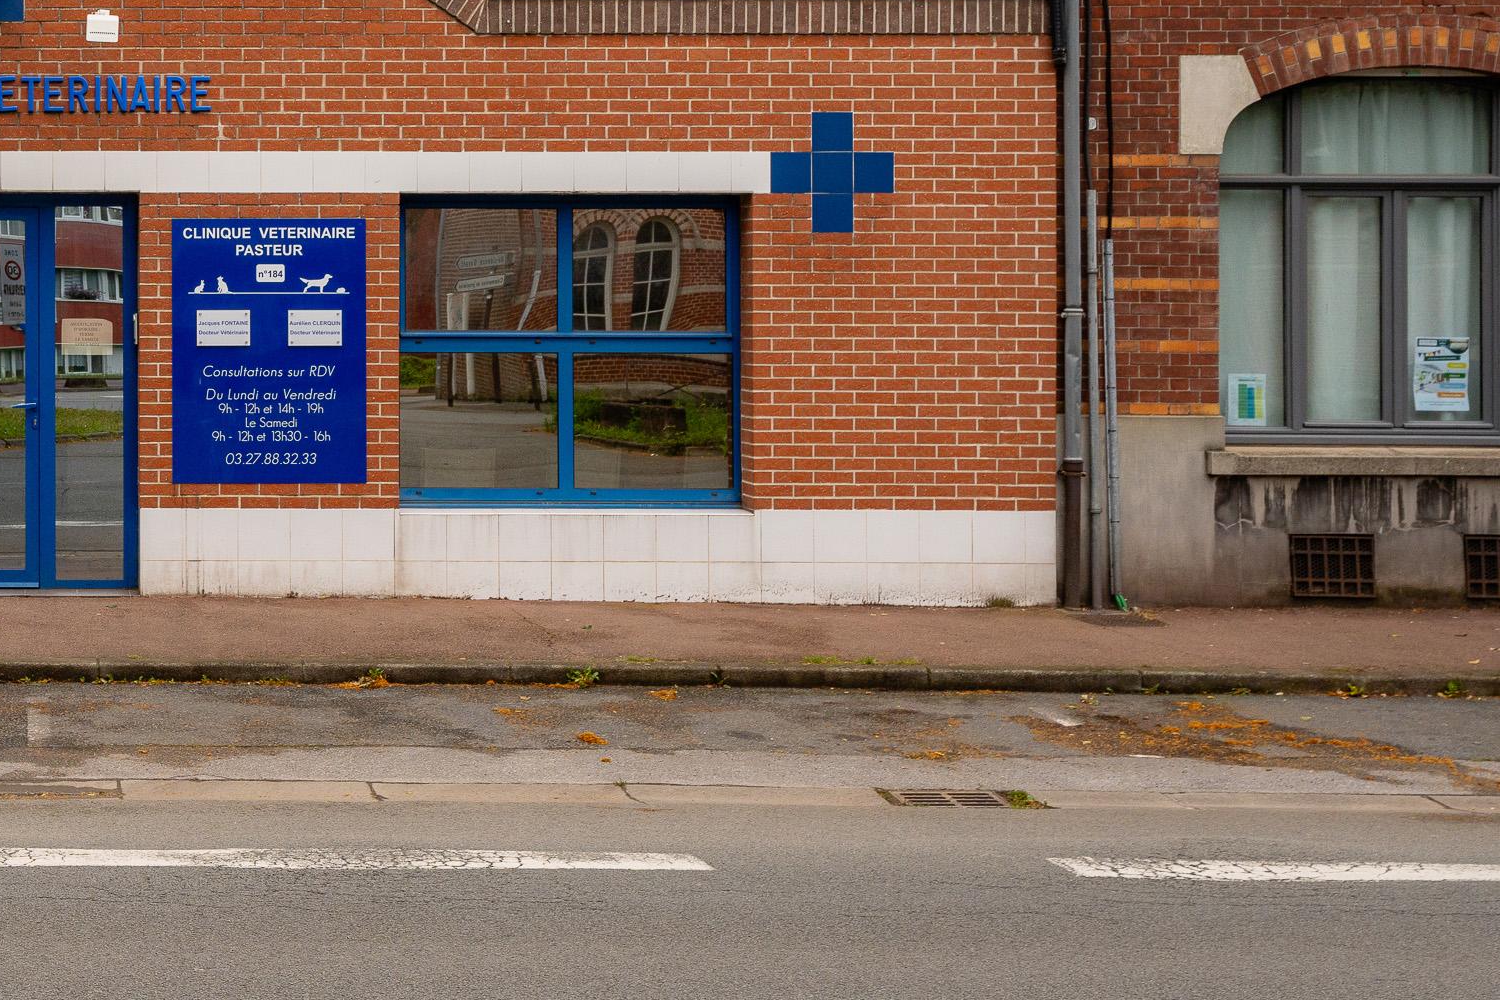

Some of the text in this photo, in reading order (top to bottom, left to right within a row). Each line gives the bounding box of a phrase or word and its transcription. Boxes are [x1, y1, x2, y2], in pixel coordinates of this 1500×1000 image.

[182, 226, 356, 239] CLINIQUE VETERINAIRE
[235, 244, 303, 256] PASTEUR
[258, 269, 283, 279] n°184
[202, 365, 336, 378] Consultations sur RDV
[205, 388, 337, 400] Du Lundi au Vendredi
[218, 402, 233, 414] 9h
[244, 402, 260, 414] 12h
[263, 404, 273, 414] et
[278, 402, 295, 414] 14h
[307, 402, 324, 414] 19h
[245, 416, 298, 428] Le Samedi
[211, 430, 226, 442] 9h
[237, 430, 254, 442] 12h
[256, 432, 267, 442] et
[271, 430, 302, 442] 13h30
[313, 430, 331, 442] 16h
[225, 452, 317, 465] 03.27.88.32.33
